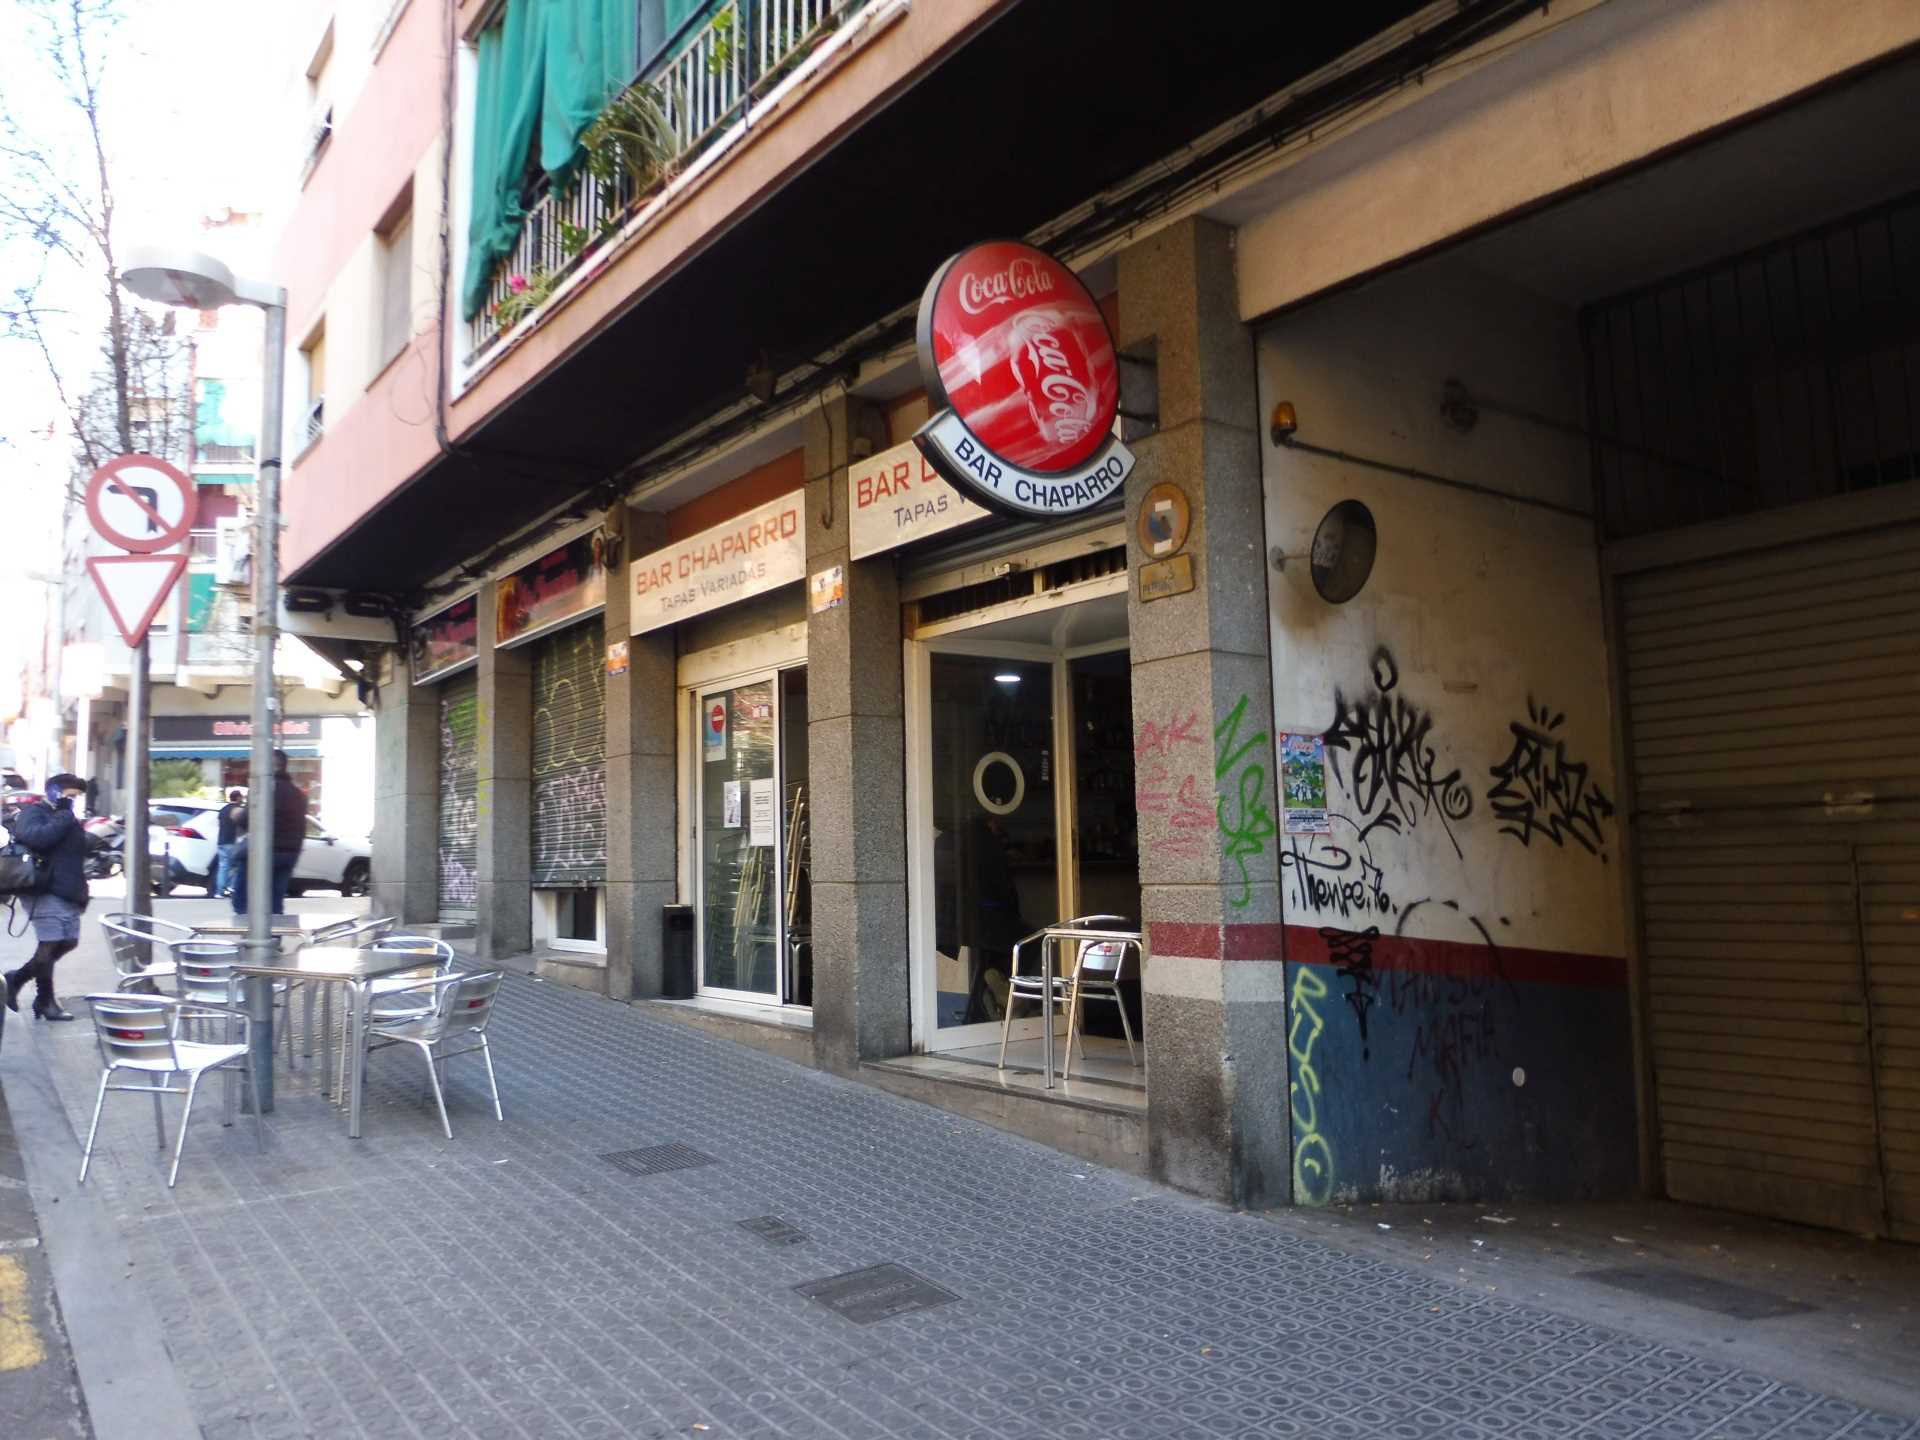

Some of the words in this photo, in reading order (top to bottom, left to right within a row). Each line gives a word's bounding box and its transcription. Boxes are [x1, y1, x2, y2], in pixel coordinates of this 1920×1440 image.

[960, 258, 1053, 314] Coca-Cola
[857, 461, 910, 509] BAR
[955, 438, 1002, 488] BAR
[1015, 456, 1124, 507] CHAPARRO
[894, 494, 948, 528] TAPAS
[636, 562, 672, 595] BAR
[678, 509, 797, 579] CHAPARRO
[660, 588, 696, 612] TAPAS
[700, 563, 766, 597] VARIADAS
